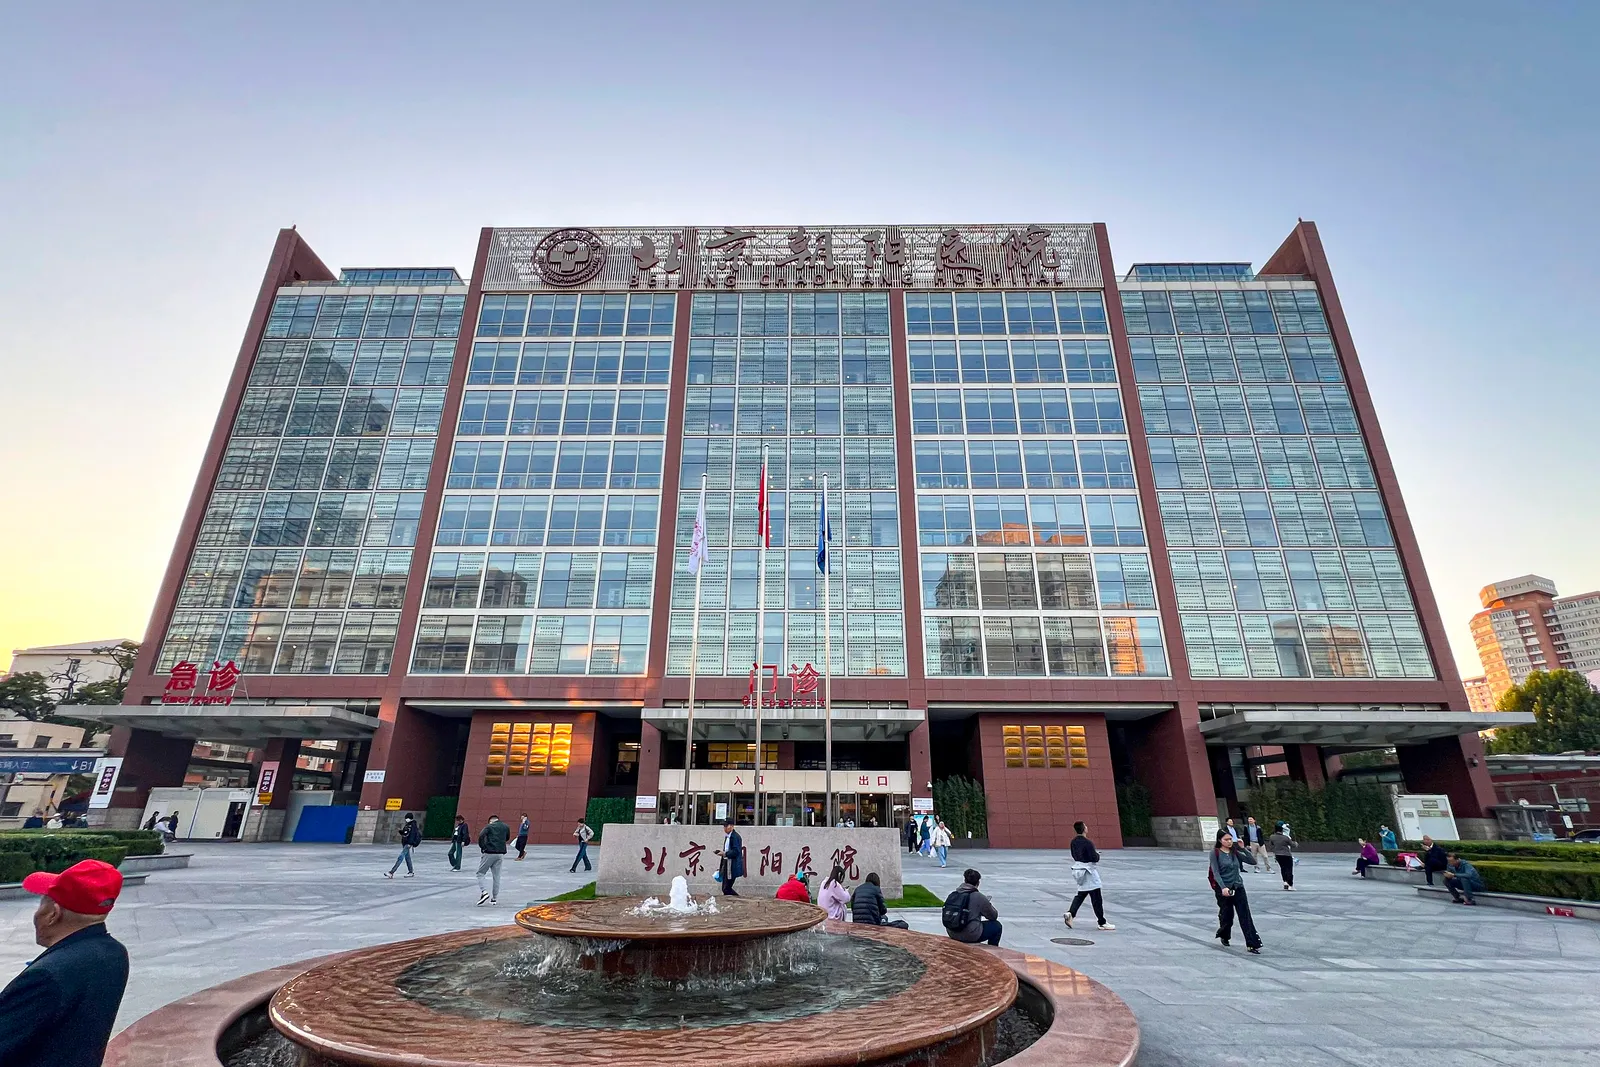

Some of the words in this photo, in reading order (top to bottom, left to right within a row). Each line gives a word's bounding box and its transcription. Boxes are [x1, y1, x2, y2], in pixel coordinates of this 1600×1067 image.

[632, 224, 1060, 272] 北京朝阳医院
[629, 274, 737, 287] BEIJING
[760, 273, 914, 287] CHAO-YANG
[935, 272, 1063, 285] HOSPITAL
[164, 660, 241, 691] 急诊
[748, 662, 820, 694] 门诊
[161, 693, 234, 706] Emergency
[79, 760, 93, 770] B1
[858, 775, 888, 787] 出口
[641, 841, 860, 881] 北京阳医院
